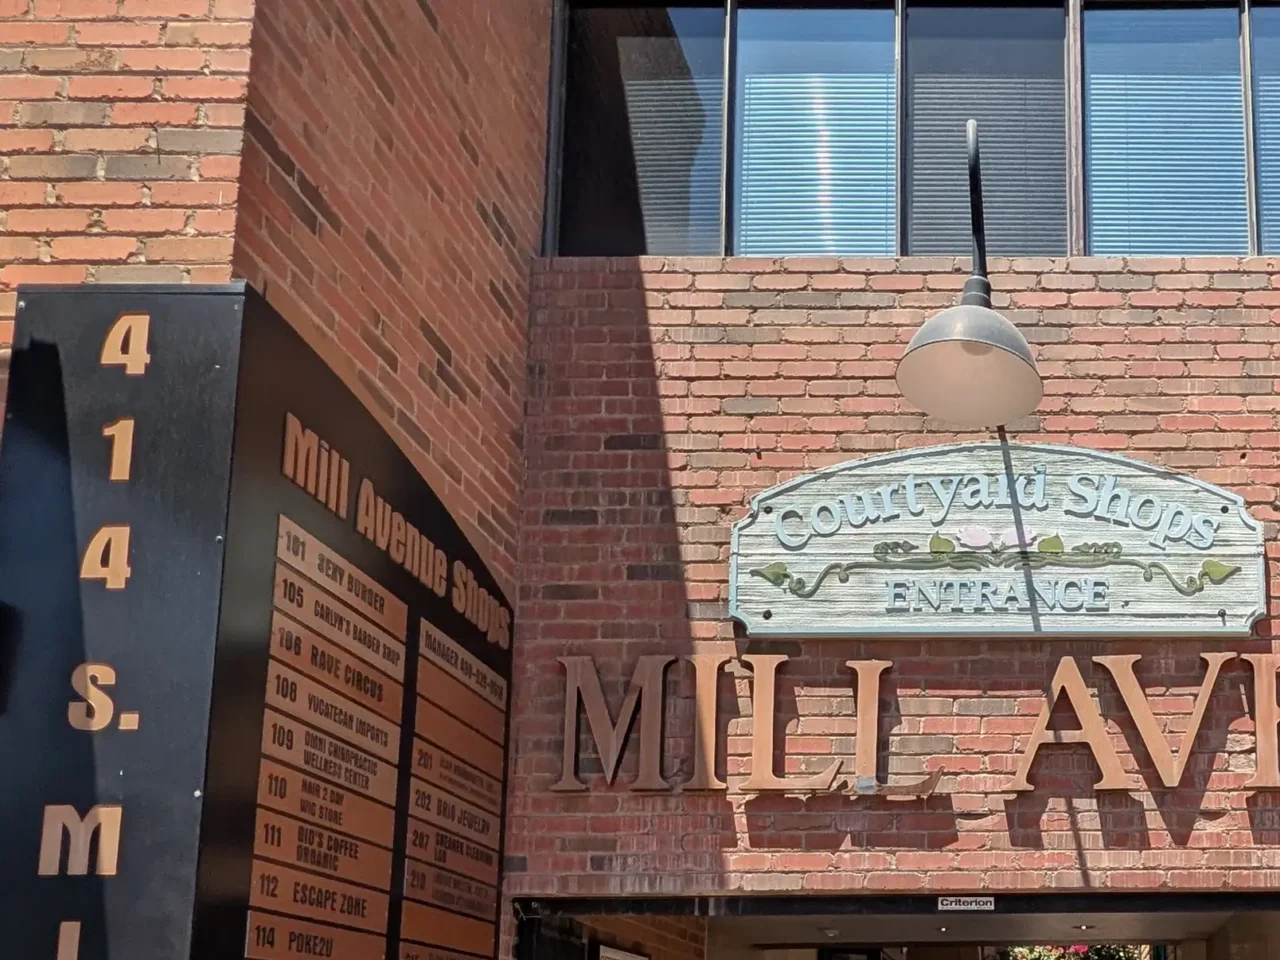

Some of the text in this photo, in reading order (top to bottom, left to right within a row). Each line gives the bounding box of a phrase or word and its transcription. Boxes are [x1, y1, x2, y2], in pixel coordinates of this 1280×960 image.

[80, 313, 151, 589] 414
[774, 463, 1221, 550] Courtyard Shops
[282, 412, 510, 649] Mill Avenue Shops
[286, 531, 306, 562] 101
[886, 578, 1110, 613] ENTRANCE
[282, 578, 304, 608] 105
[353, 624, 381, 655] BARBER
[382, 644, 401, 667] SHOP
[311, 645, 342, 679] RAVE
[344, 664, 383, 702] CIRCUS
[68, 663, 139, 731] S.
[271, 723, 294, 750] 109
[308, 693, 354, 731] YUCATECAN
[356, 717, 389, 748] IMPORTS
[550, 653, 945, 798] MILL
[267, 772, 287, 800] 110
[304, 749, 370, 790] WELLNESS CENTER
[263, 823, 282, 847] 111
[327, 835, 359, 860] COFFEE
[260, 872, 367, 918] 112 ESCAPE ZONE
[940, 898, 993, 907] Criterion
[255, 925, 333, 958] 114 POKE2U
